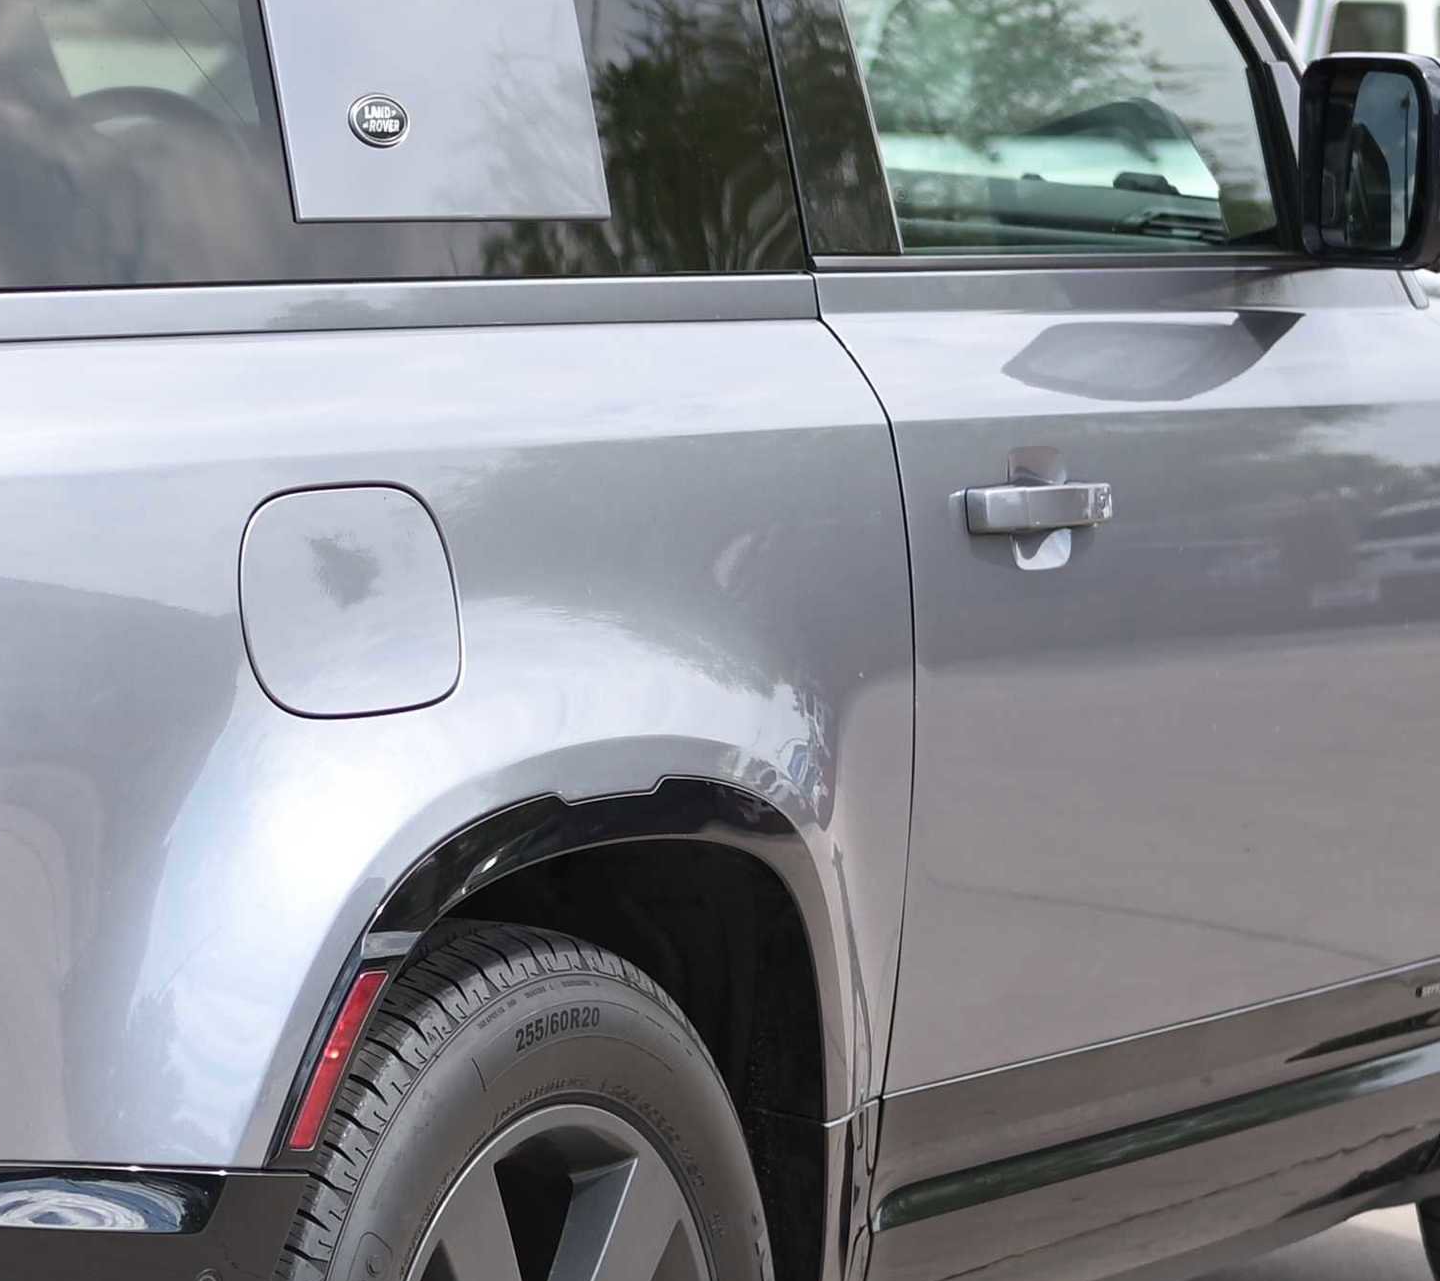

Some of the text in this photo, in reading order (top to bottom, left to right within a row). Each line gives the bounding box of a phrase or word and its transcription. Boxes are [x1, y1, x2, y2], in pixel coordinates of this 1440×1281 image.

[363, 105, 392, 119] LAND
[368, 119, 400, 133] ROVER
[514, 1005, 601, 1053] 255/60R20
